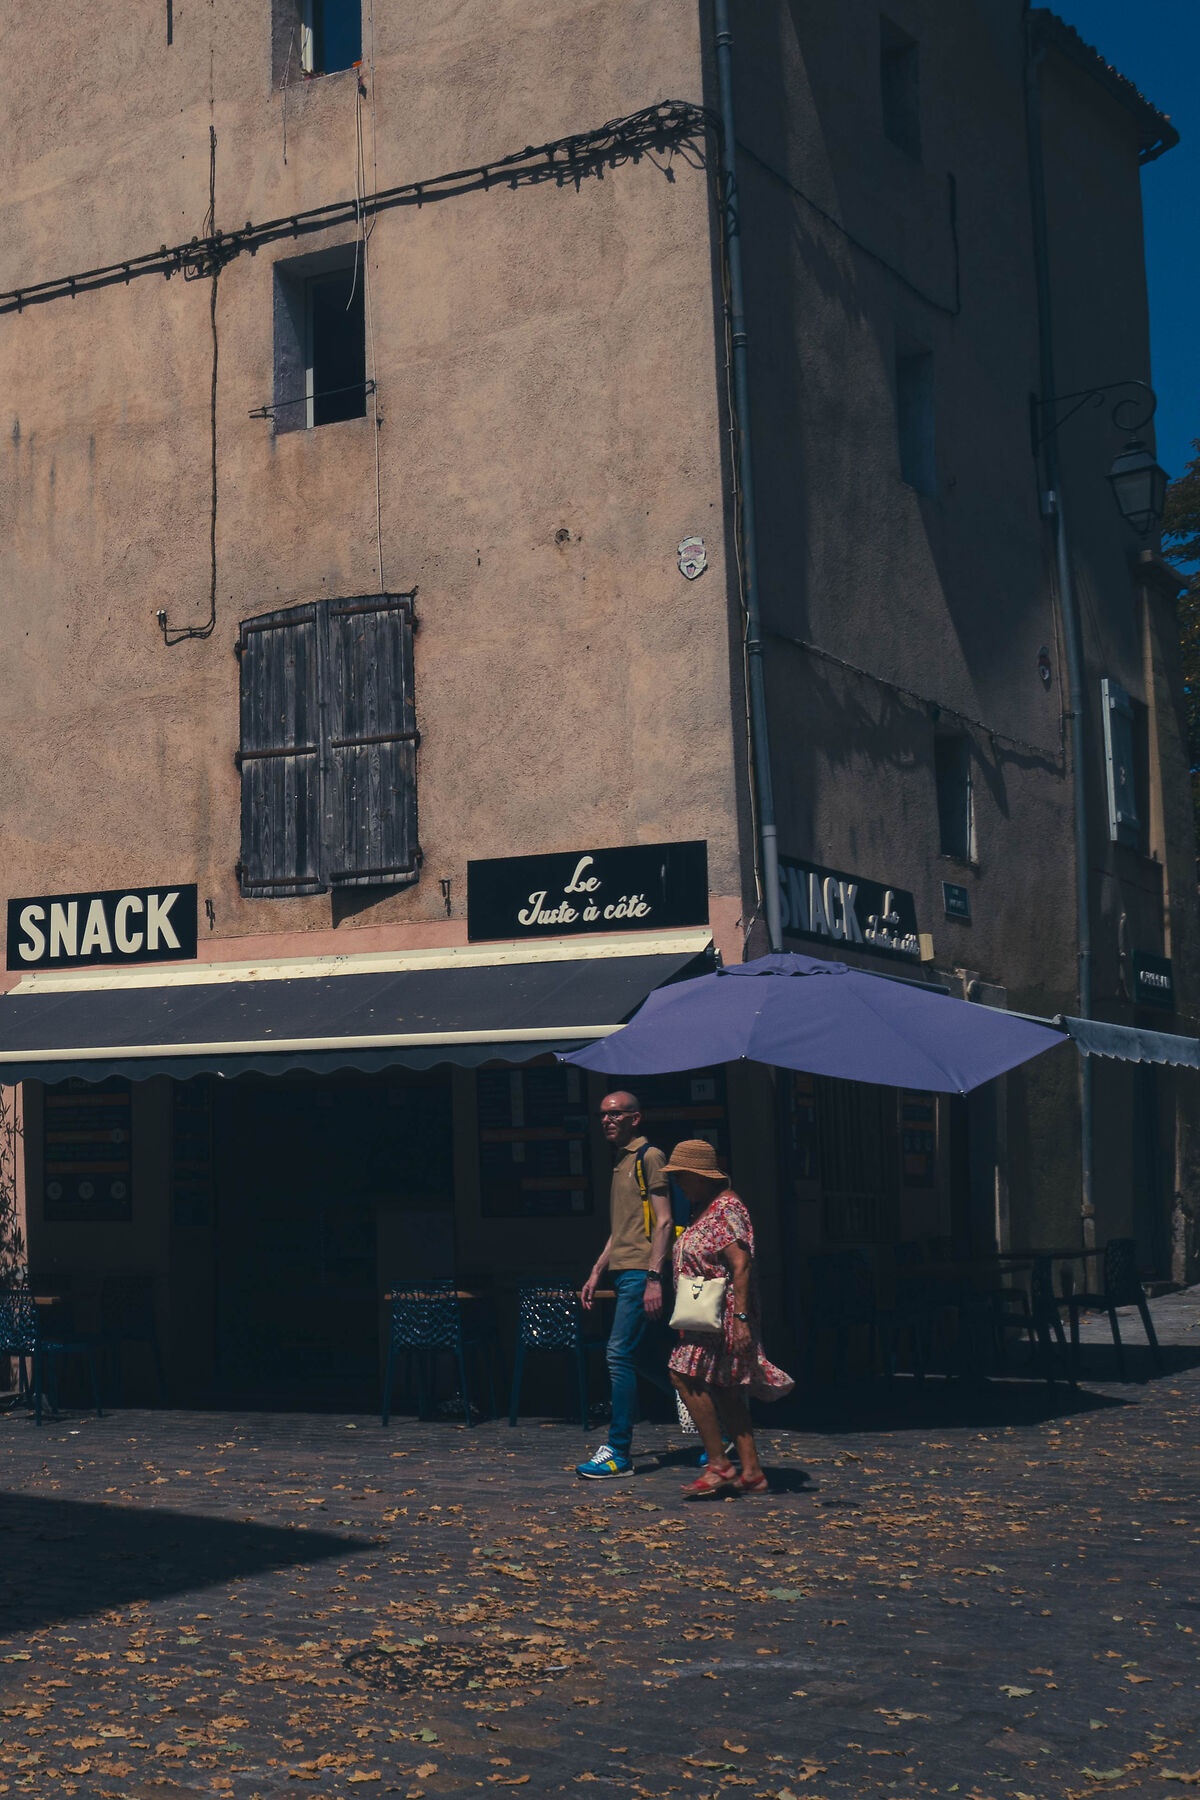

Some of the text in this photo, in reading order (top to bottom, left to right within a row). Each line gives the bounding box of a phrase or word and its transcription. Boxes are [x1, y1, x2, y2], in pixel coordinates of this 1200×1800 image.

[564, 855, 601, 894] Le
[18, 892, 181, 962] SNACK
[517, 890, 652, 926] Juste à côté
[778, 863, 864, 944] SNACK
